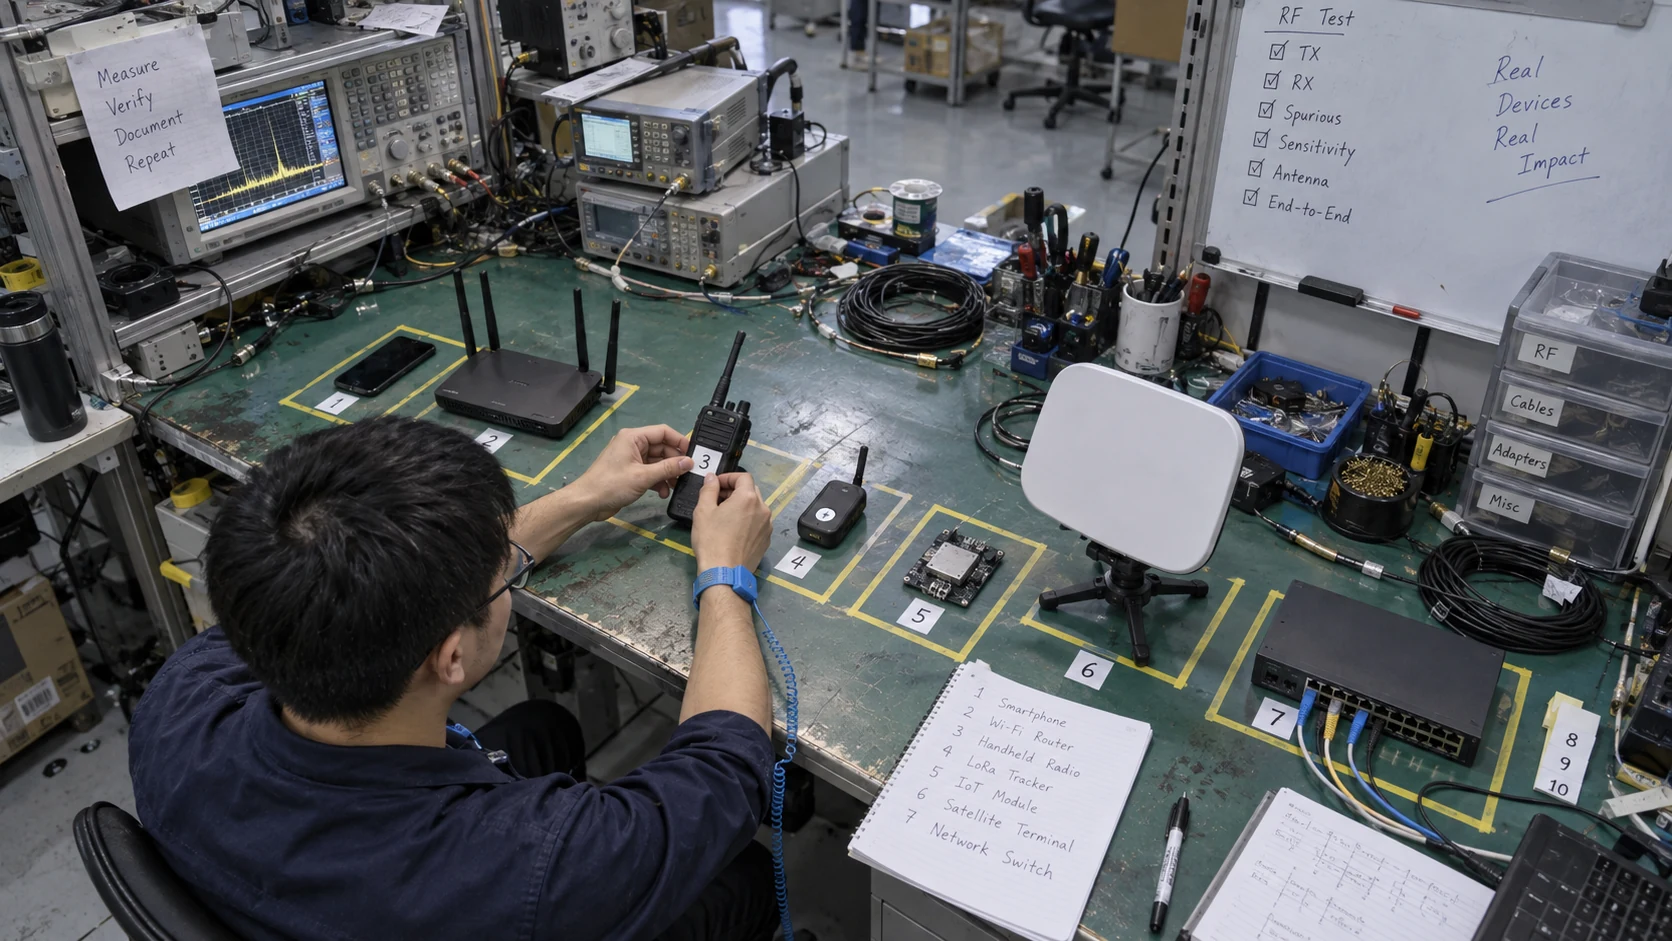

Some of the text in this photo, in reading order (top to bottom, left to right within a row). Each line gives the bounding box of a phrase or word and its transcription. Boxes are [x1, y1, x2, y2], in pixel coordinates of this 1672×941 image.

[1278, 6, 1355, 28] RF Test
[1300, 45, 1321, 62] TX
[97, 60, 160, 88] Measure
[1291, 74, 1314, 91] RX
[1488, 55, 1544, 86] Real
[105, 87, 153, 116] Verify
[1496, 92, 1573, 118] Devices
[113, 109, 183, 146] Document
[1284, 104, 1342, 127] Spurious
[1494, 123, 1537, 151] Real
[124, 142, 176, 174] Repeat
[1278, 134, 1356, 166] Sensitivity
[1517, 147, 1591, 180] Impact
[1272, 164, 1330, 189] Antenna
[1268, 194, 1353, 225] End-to-End
[1534, 343, 1559, 362] RF
[330, 397, 343, 408] 1
[1510, 394, 1555, 418] Cables
[483, 435, 498, 447] 2
[699, 454, 710, 469] 3
[1492, 443, 1547, 471] Adapters
[1489, 494, 1520, 513] Misc
[791, 556, 806, 569] 4
[911, 608, 931, 623] 5
[1081, 662, 1097, 678] 6
[973, 686, 1067, 730] 1 Smartphone
[1271, 707, 1286, 726] 7
[963, 706, 1075, 753] 2 Wi-Fi Router
[1566, 733, 1578, 748] 8
[952, 725, 1082, 779] 3 Handheld Radio
[1559, 756, 1571, 771] 9
[942, 744, 1055, 793] 4 LoRa Tracker
[929, 765, 1038, 815] 5 IoT Module
[1549, 779, 1569, 797] 10
[916, 787, 1076, 853] 6 Satellite Terminal
[904, 809, 1054, 881] 7 Network Switch
